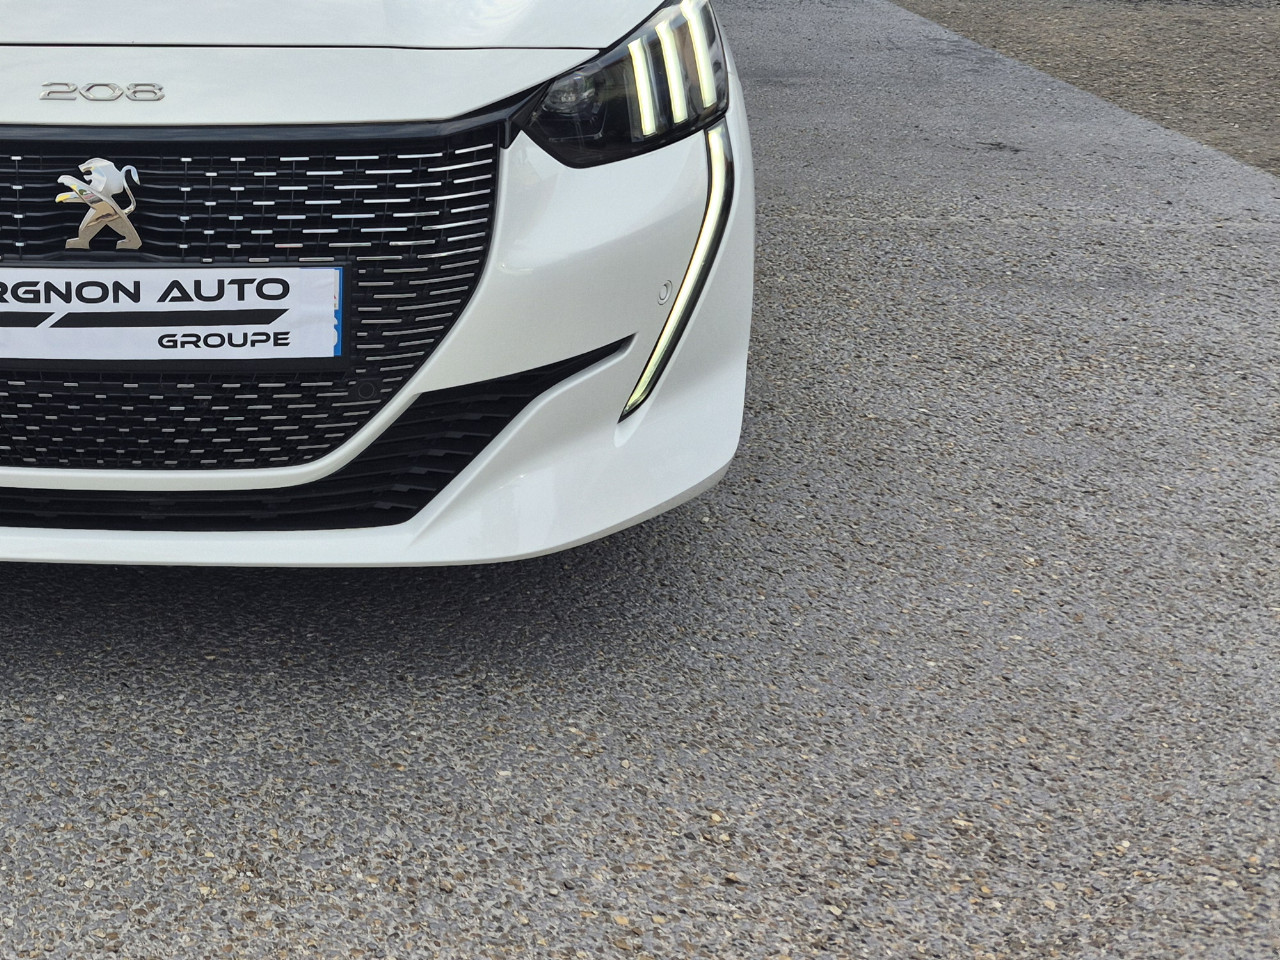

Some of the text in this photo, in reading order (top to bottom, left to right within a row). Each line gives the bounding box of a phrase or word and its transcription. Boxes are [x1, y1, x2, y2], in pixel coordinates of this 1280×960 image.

[39, 81, 165, 102] 208
[157, 277, 291, 303] AUTO
[157, 331, 291, 350] GROUPE
